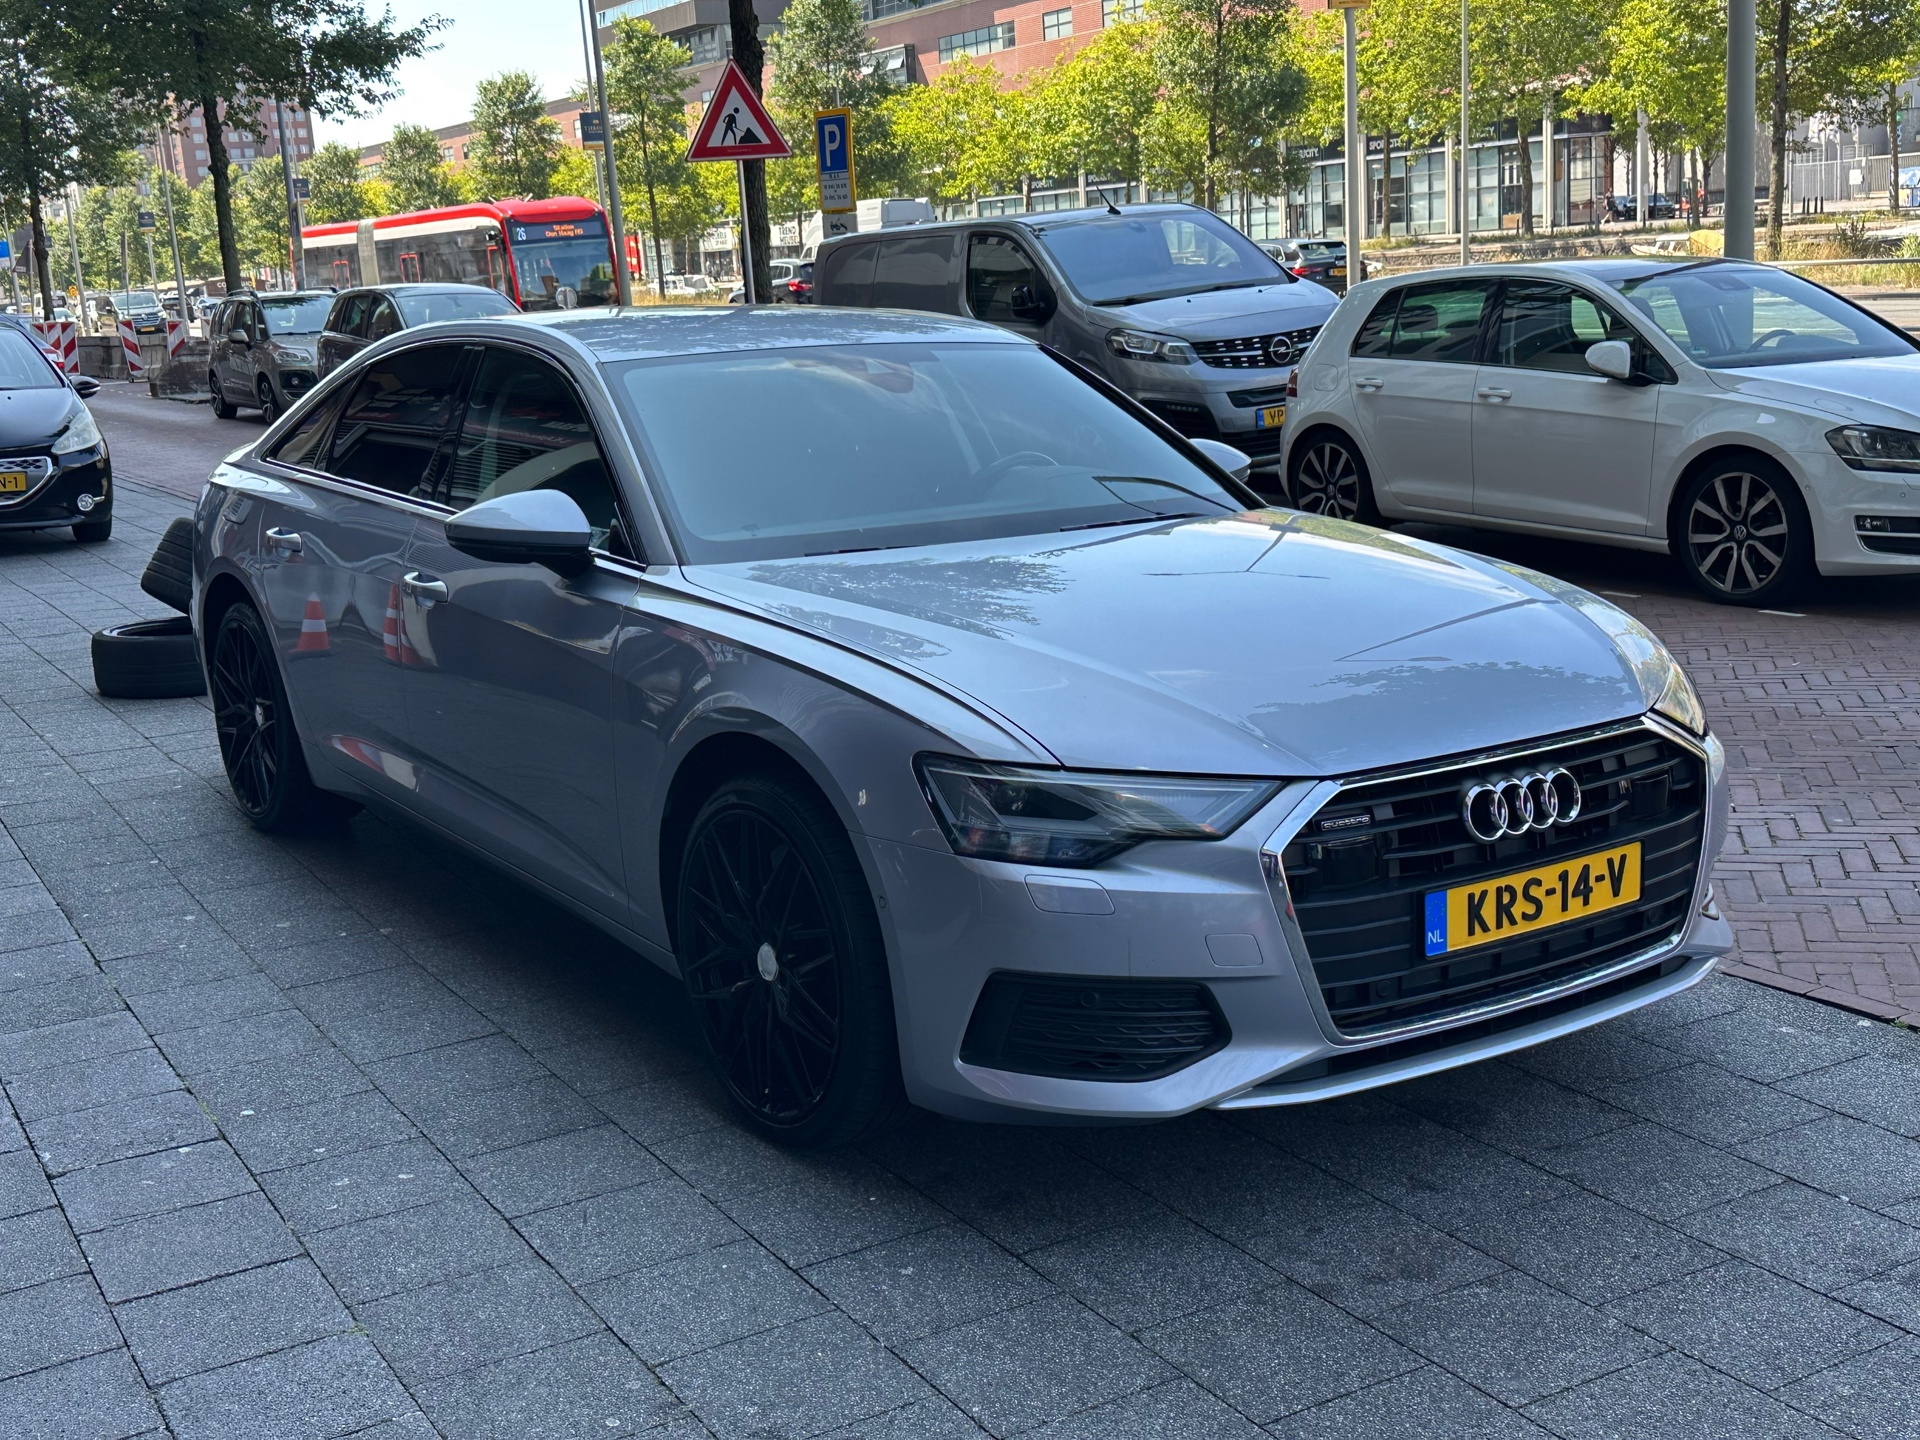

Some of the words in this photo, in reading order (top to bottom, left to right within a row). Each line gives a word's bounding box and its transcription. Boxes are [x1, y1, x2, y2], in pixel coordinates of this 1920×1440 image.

[824, 123, 841, 167] P
[516, 227, 527, 241] 26
[1323, 816, 1370, 830] quattro
[1467, 853, 1627, 937] KRS-14-V
[1428, 930, 1444, 945] NL
